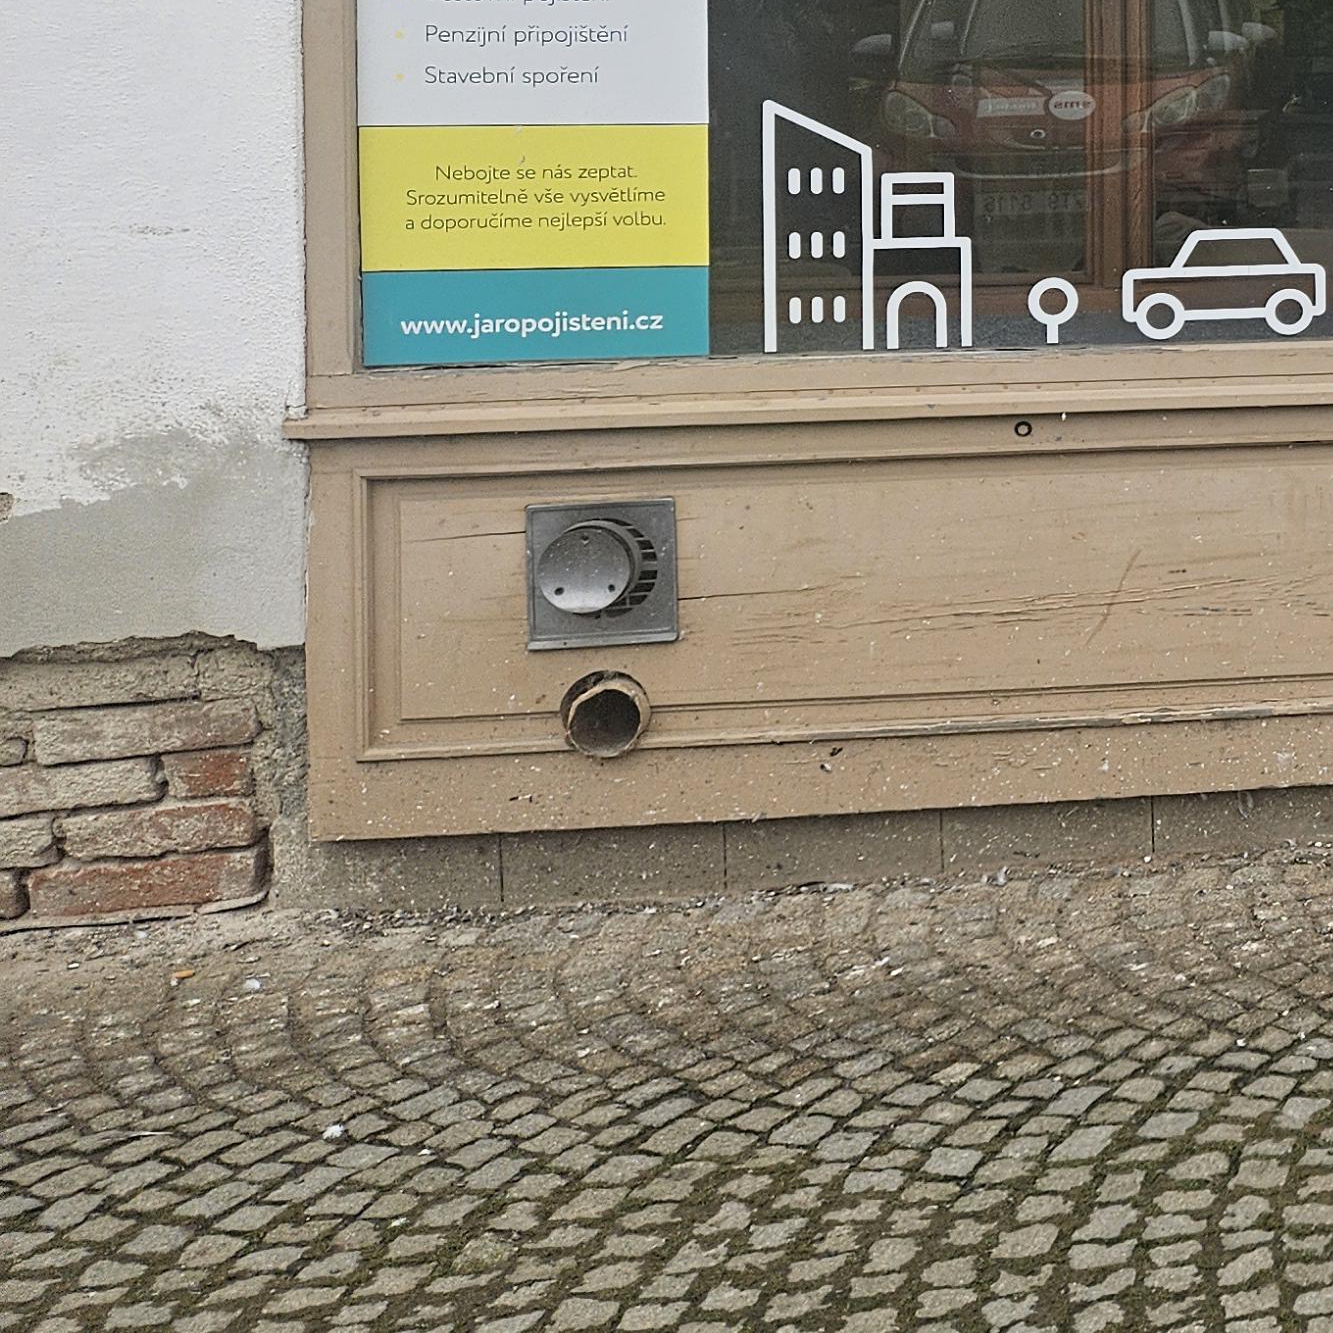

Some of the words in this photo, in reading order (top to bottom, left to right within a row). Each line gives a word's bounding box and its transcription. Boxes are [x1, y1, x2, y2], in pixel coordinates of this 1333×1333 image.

[425, 25, 507, 47] Penzijní
[514, 25, 629, 47] připojištění
[424, 66, 515, 86] Stavební
[522, 67, 600, 88] spoření
[435, 165, 510, 184] Nebojte
[516, 167, 537, 180] se
[542, 164, 572, 180] nás
[577, 165, 638, 184] zeptat.
[406, 188, 529, 206] Srozumitelně
[534, 188, 564, 204] vše
[569, 186, 666, 207] vysvětlíme
[405, 217, 416, 230] a
[420, 214, 533, 234] doporučíme
[538, 211, 608, 233] nejlepší
[613, 210, 667, 226] volbu.
[400, 311, 664, 339] www.jaropojisteni.cz
